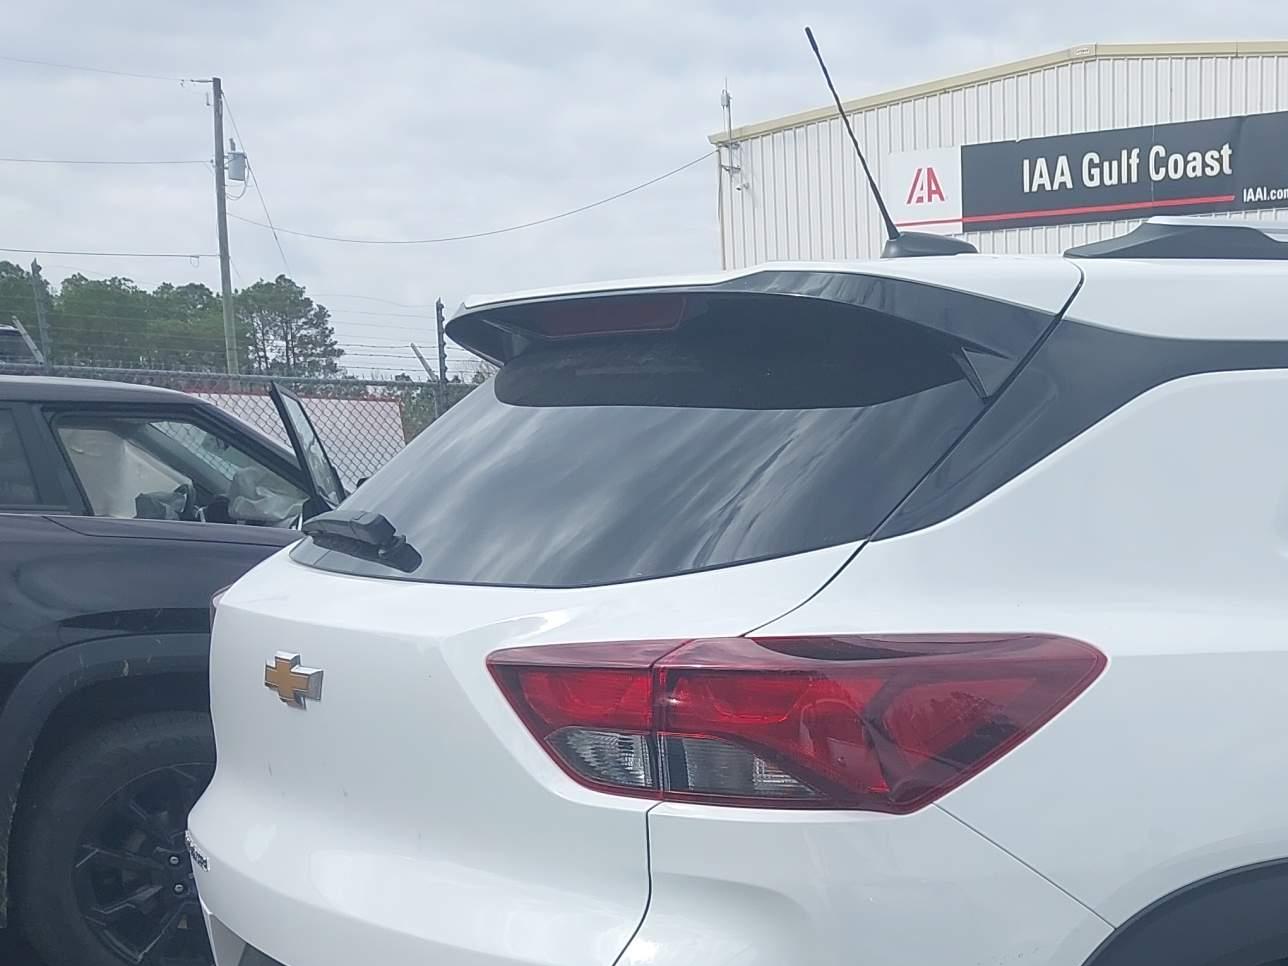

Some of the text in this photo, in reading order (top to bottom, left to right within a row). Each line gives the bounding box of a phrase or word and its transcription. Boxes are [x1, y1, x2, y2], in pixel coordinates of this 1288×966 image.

[1022, 142, 1233, 193] IAA Gulf Coast
